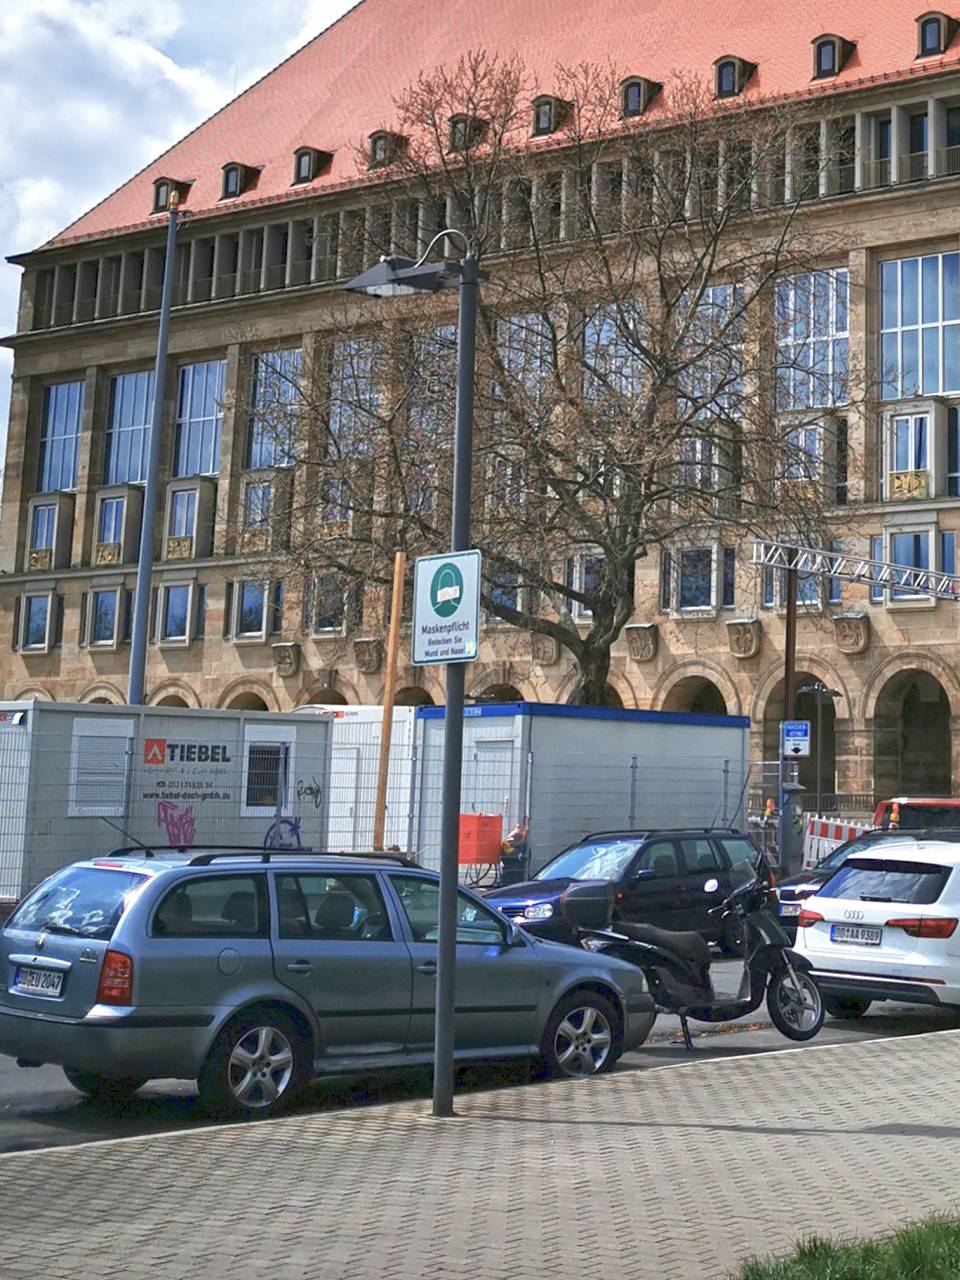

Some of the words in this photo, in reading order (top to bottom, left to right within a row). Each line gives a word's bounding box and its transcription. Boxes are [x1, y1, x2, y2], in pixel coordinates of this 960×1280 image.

[421, 621, 469, 634] Maskenpflicht
[428, 637, 452, 646] Bedecken
[454, 635, 462, 643] Sie
[424, 648, 438, 657] Mund
[440, 648, 449, 656] und
[166, 743, 231, 763] TIEBEL
[860, 929, 880, 942] 9389
[41, 973, 61, 990] 2047
